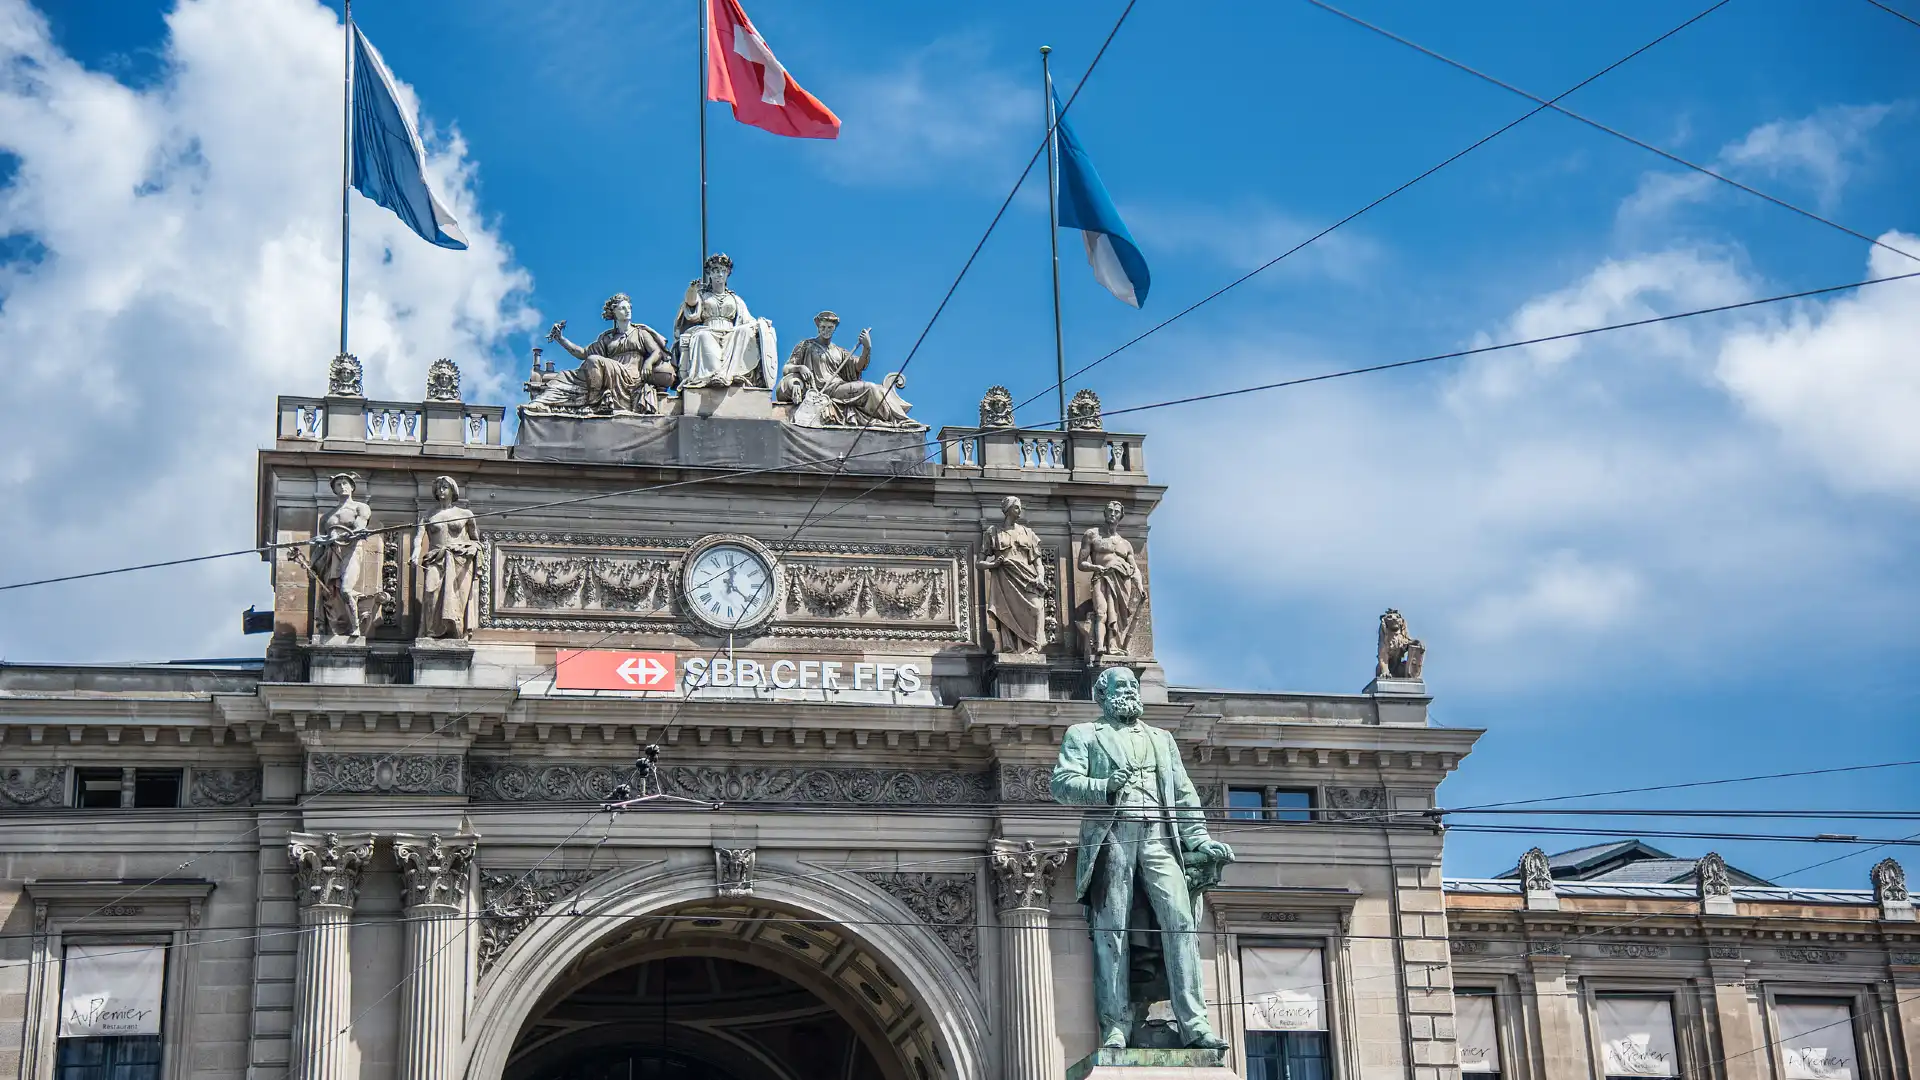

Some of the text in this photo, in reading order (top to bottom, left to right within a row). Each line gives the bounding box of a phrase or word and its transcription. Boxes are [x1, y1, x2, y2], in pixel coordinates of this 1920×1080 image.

[686, 658, 921, 692] SBB CFF FFS
[102, 1023, 138, 1031] Restaurant
